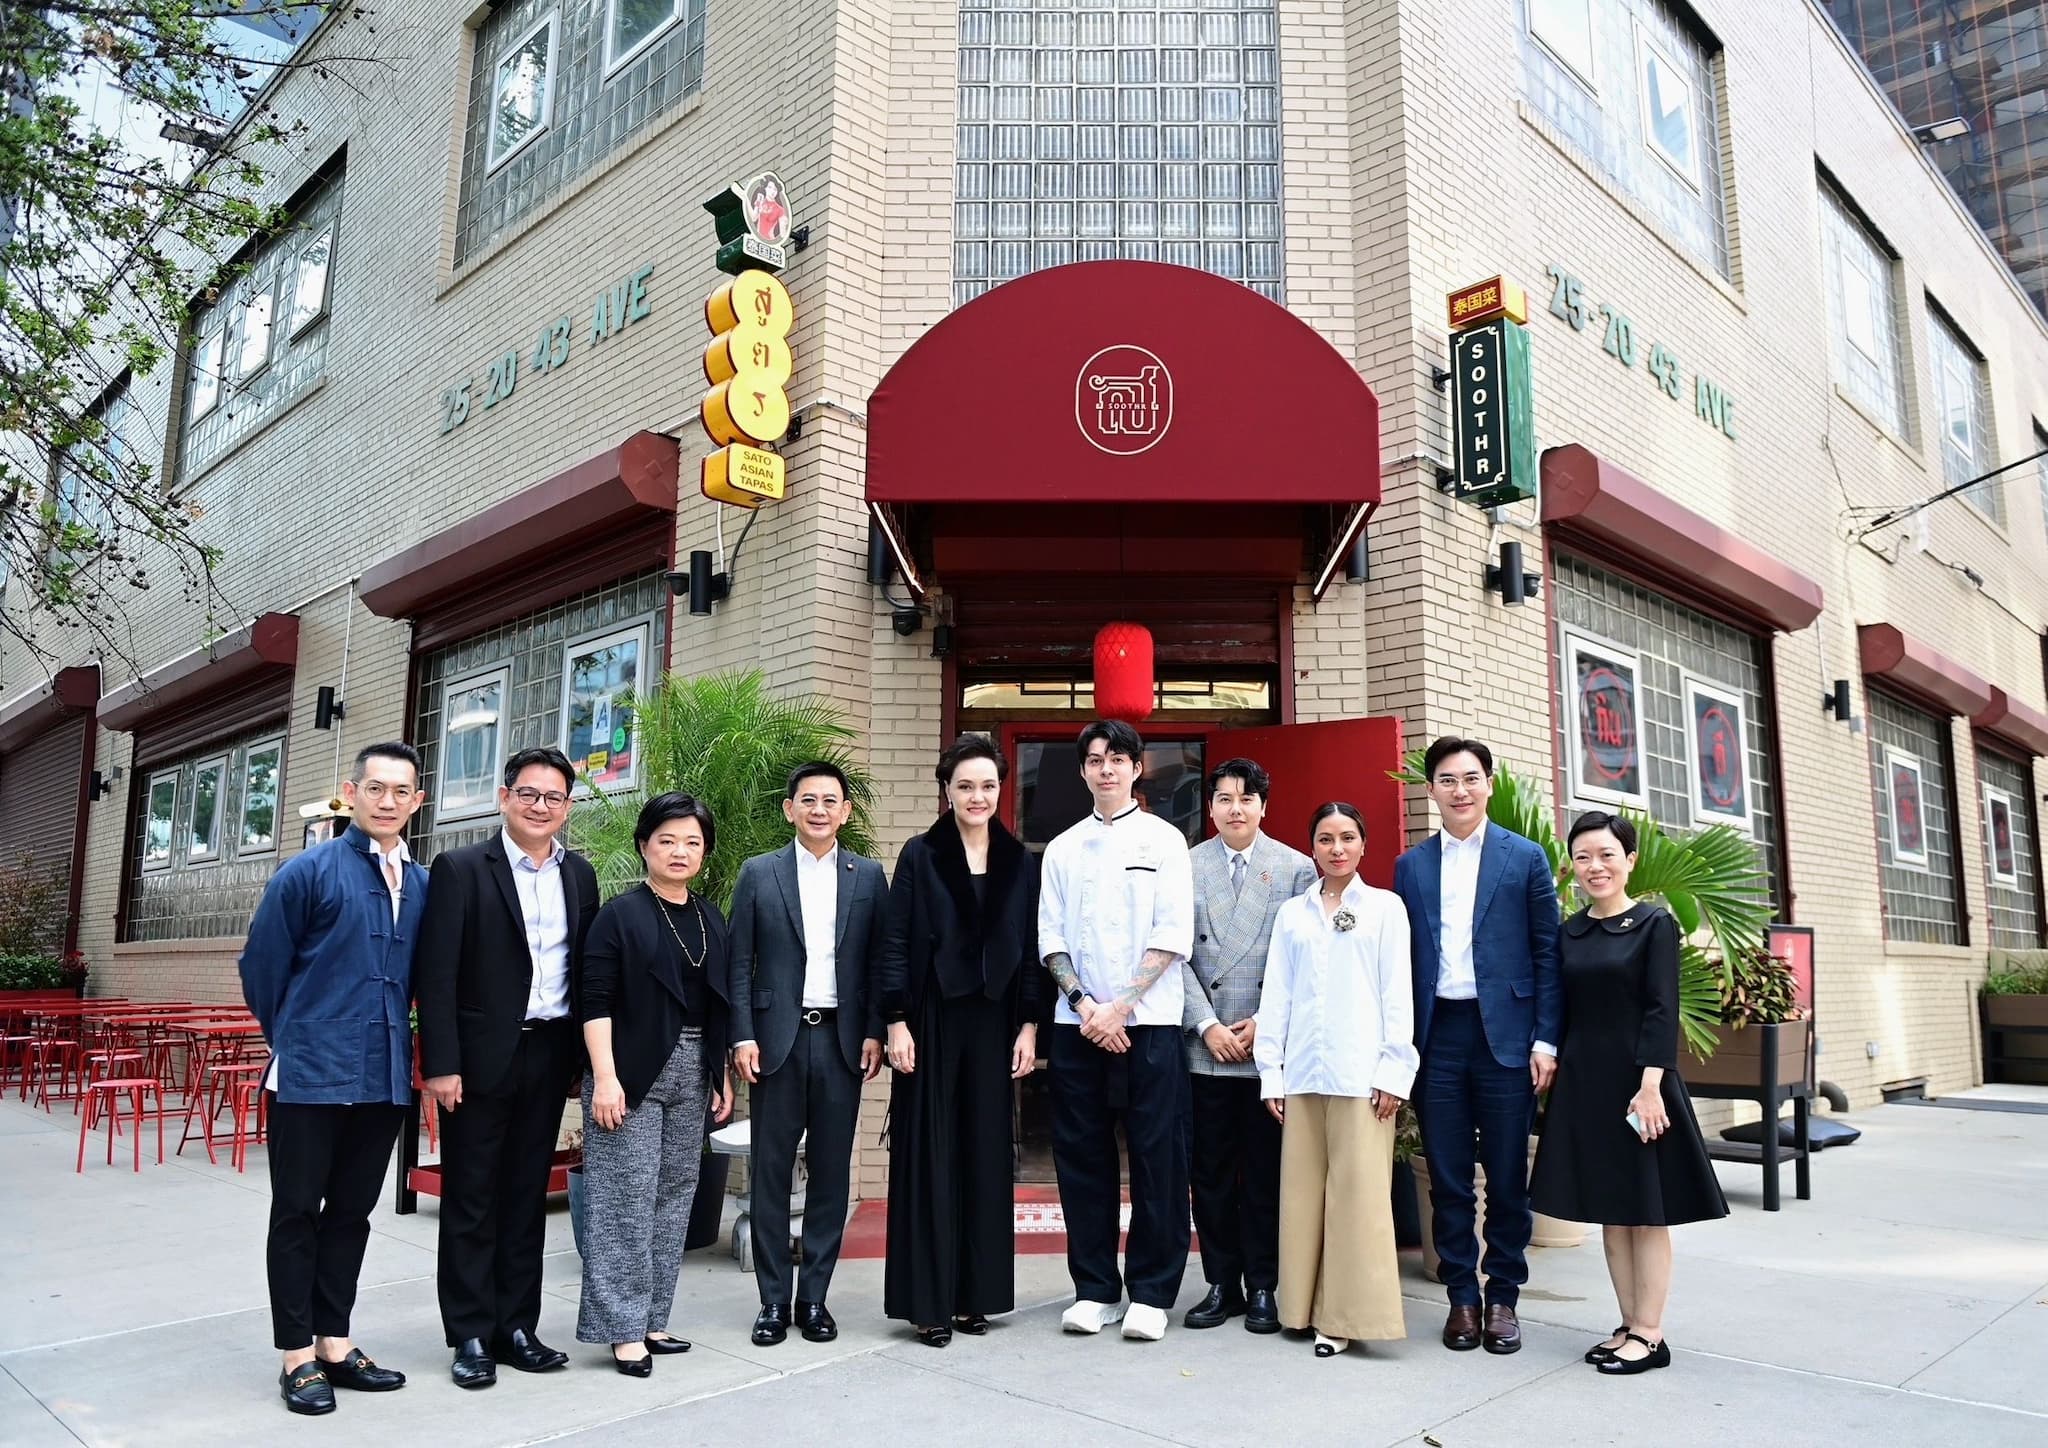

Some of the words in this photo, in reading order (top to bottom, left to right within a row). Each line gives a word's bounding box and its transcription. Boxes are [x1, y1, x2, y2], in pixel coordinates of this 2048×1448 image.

[1453, 286, 1497, 317] 泰国菜
[531, 315, 572, 376] 43
[589, 261, 655, 349] AVE
[1648, 341, 1682, 402] 43
[1695, 374, 1736, 442] AVE
[1108, 402, 1147, 410] SOOTHR
[1470, 342, 1490, 475] SOOTHR
[740, 463, 774, 480] ASIAN
[743, 451, 772, 466] SATO
[740, 475, 774, 492] TAPAS
[595, 702, 608, 730] A
